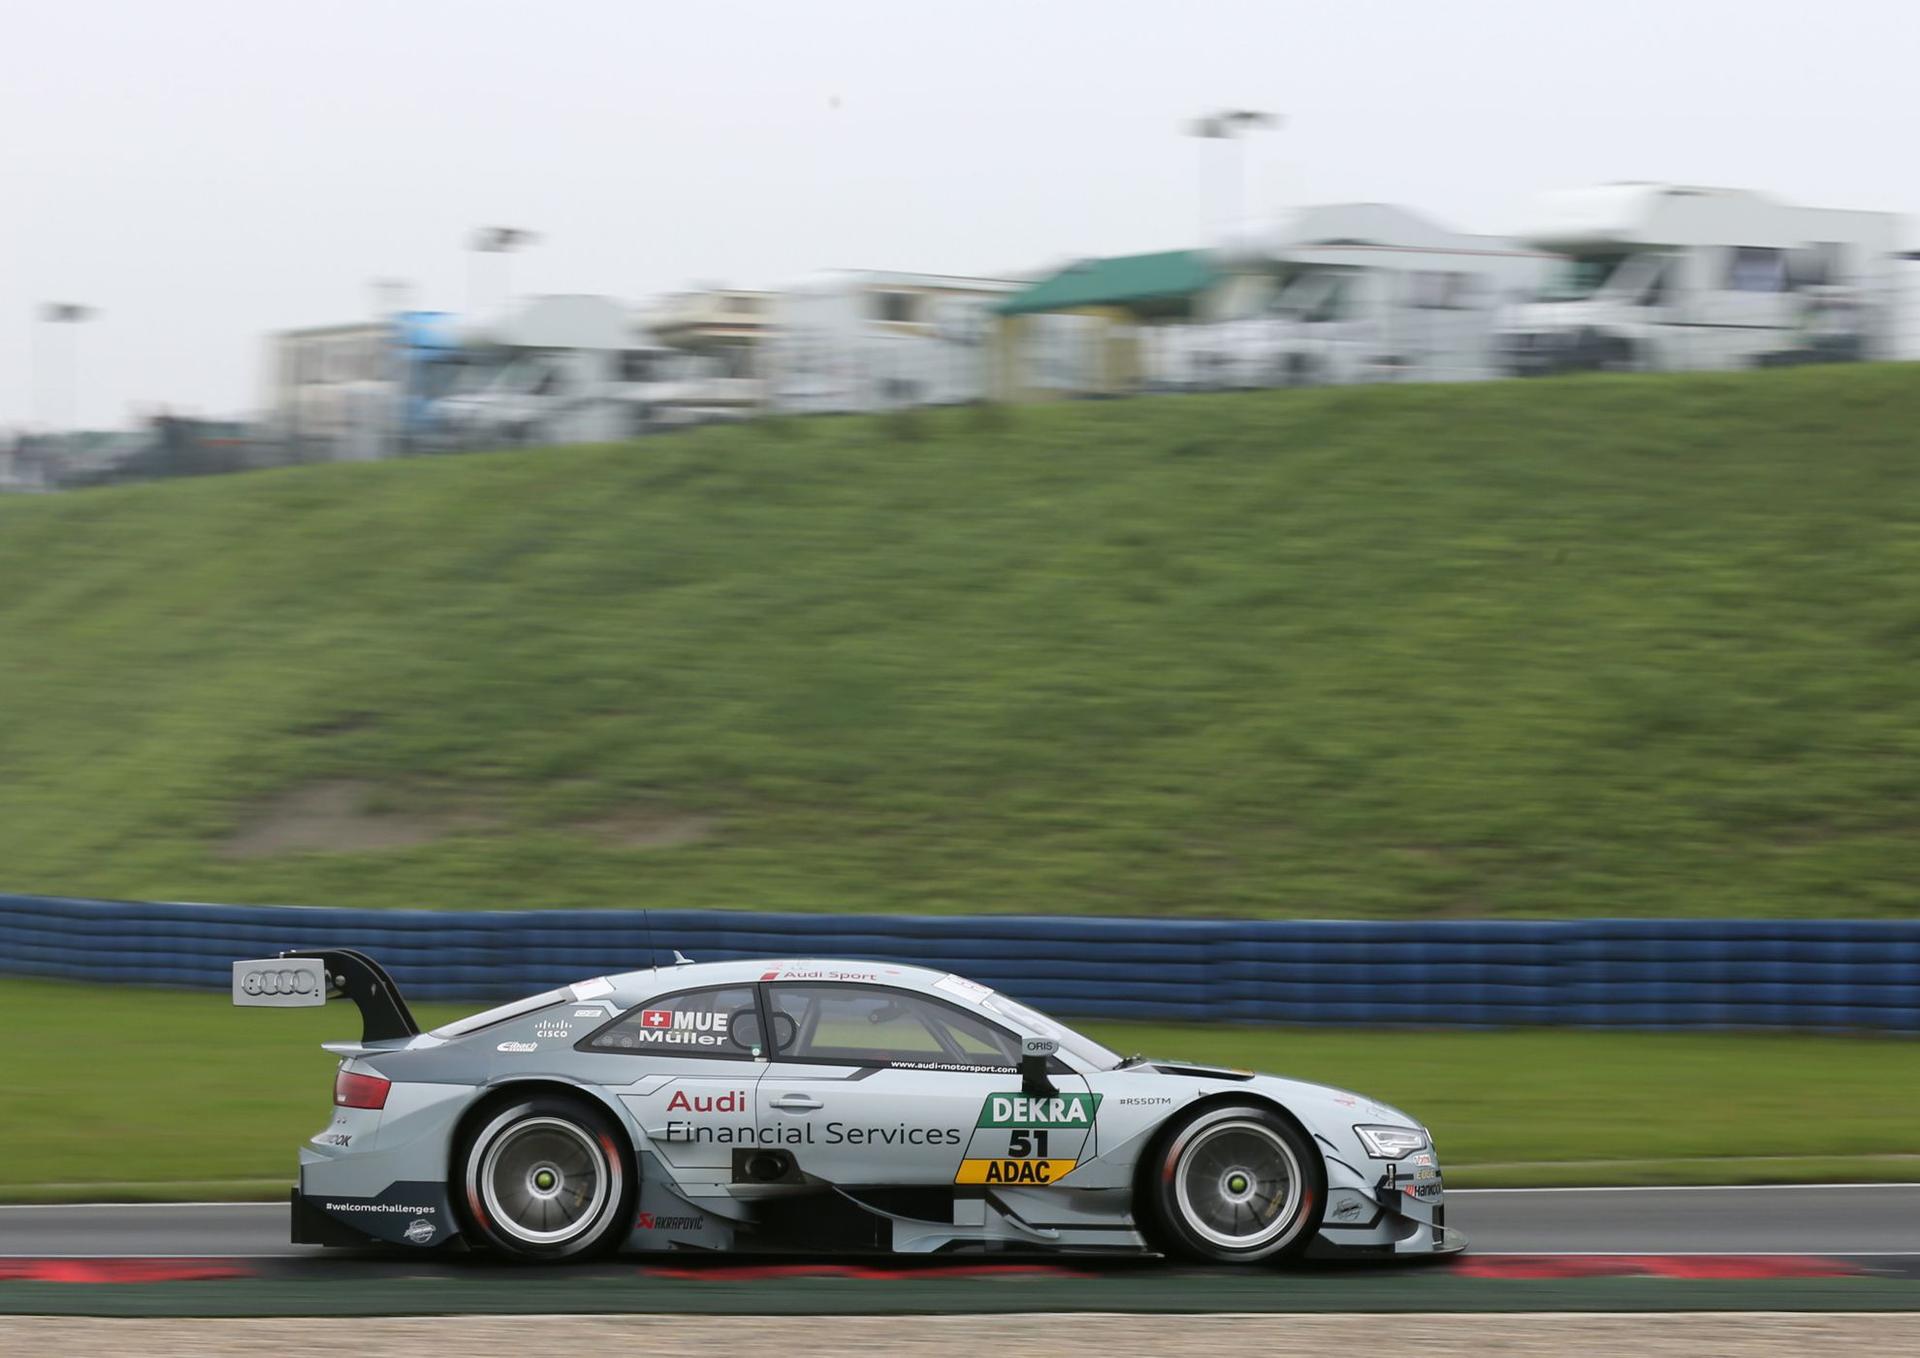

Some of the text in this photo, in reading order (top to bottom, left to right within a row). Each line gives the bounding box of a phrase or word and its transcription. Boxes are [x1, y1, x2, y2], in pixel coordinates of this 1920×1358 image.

[784, 971, 877, 982] Audi Sport
[673, 1011, 728, 1032] MUE
[639, 1029, 728, 1045] Müller
[1027, 1041, 1053, 1051] ORIS
[891, 1060, 1018, 1074] www.audi-motorsport.com
[666, 1090, 746, 1112] Audi
[992, 1097, 1088, 1123] DEKRA
[666, 1121, 961, 1145] Financial Services
[1008, 1130, 1049, 1158] 51
[985, 1161, 1051, 1183] ADAC
[326, 1203, 436, 1214] #welcomechallenges
